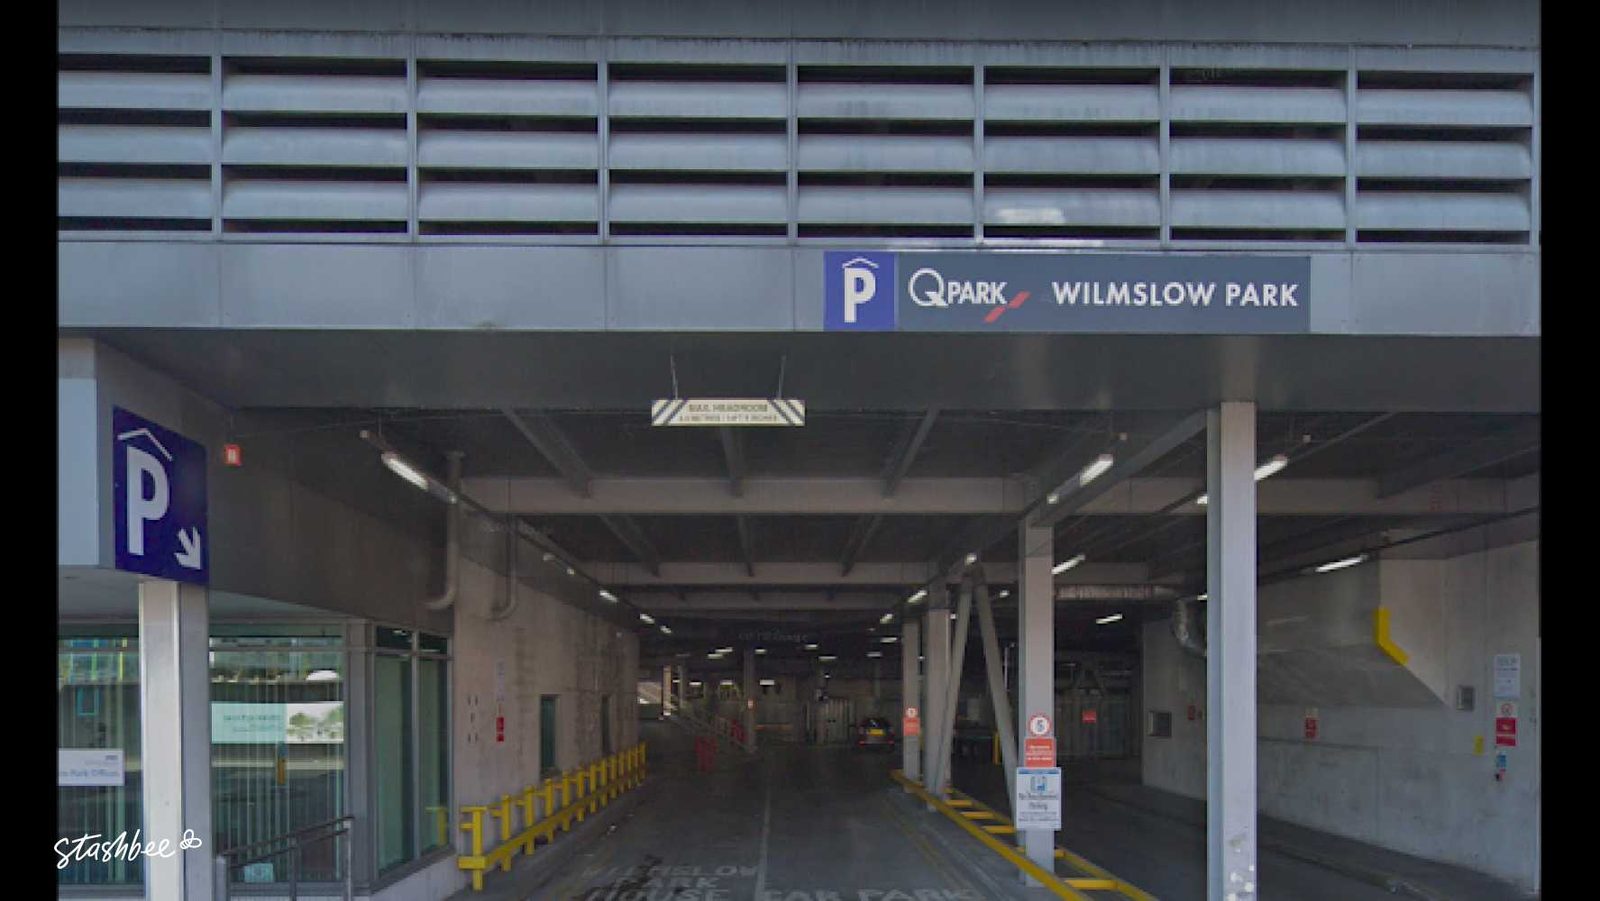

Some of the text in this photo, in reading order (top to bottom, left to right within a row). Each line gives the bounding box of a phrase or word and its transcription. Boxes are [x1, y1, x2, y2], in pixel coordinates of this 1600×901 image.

[843, 267, 877, 323] P
[1051, 280, 1300, 308] WILMSLOW PARK
[126, 446, 171, 556] P
